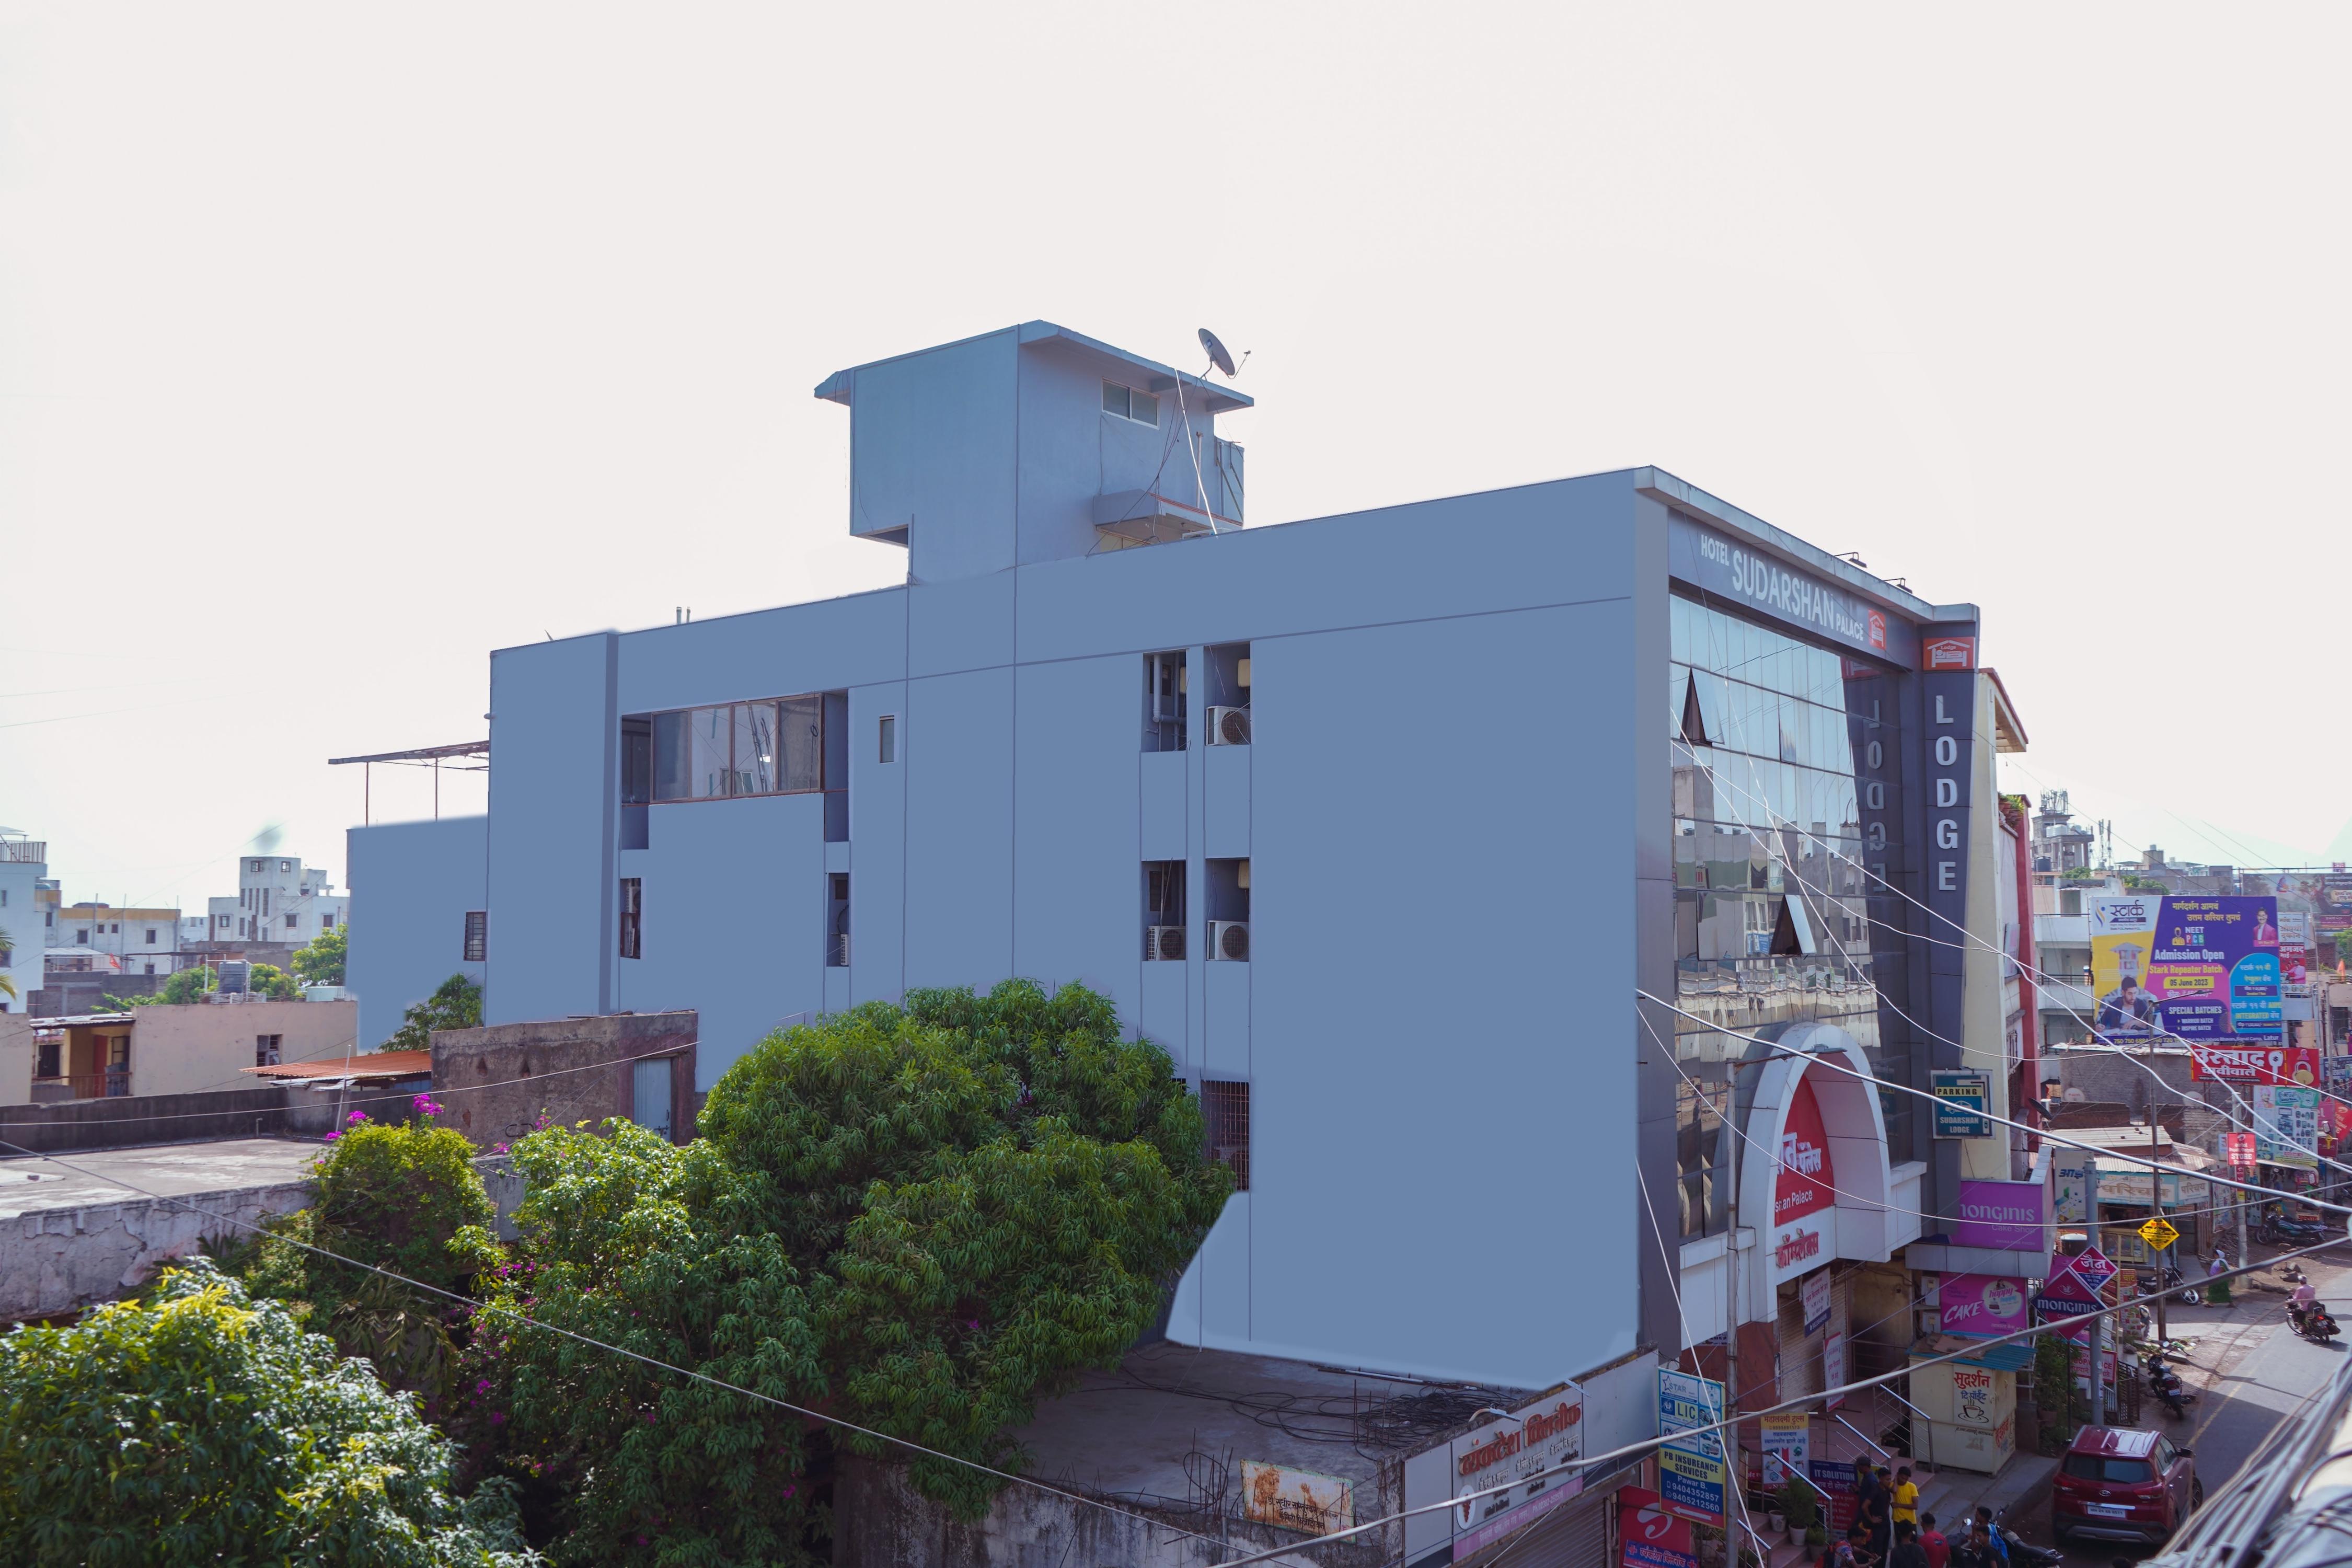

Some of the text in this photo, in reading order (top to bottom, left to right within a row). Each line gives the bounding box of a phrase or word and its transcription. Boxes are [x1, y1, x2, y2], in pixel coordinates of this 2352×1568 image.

[1701, 534, 1863, 641] HOTEL SUDARSHAN PALACE
[1935, 695, 1958, 891] LODGE
[2109, 900, 2145, 916] स्टार्क
[2172, 901, 2199, 910] मार्गदर्शन
[2204, 912, 2224, 921] करियर
[2154, 949, 2224, 962] Admission Open
[2149, 965, 2223, 975] Stark Repeater Batch
[2194, 1049, 2265, 1066] उस्ताद
[2181, 1182, 2206, 1192] परिचय
[1792, 1190, 1813, 1207] Palace
[2014, 1226, 2035, 1235] Shop
[2080, 1254, 2107, 1270] जैन
[1944, 1300, 1984, 1323] CAKE
[1669, 1382, 1687, 1393] STAR
[1954, 1370, 1990, 1389] सुदर्शन
[1677, 1403, 1696, 1419] LIC
[1664, 1451, 1718, 1473] PB INSUREANCE
[1675, 1463, 1708, 1480] SERVICES
[1822, 1471, 1855, 1481] SOLUTION
[1677, 1475, 1708, 1490] Pawar B.
[1672, 1483, 1719, 1502] 9404352857
[1672, 1492, 1720, 1513] 9405212560
